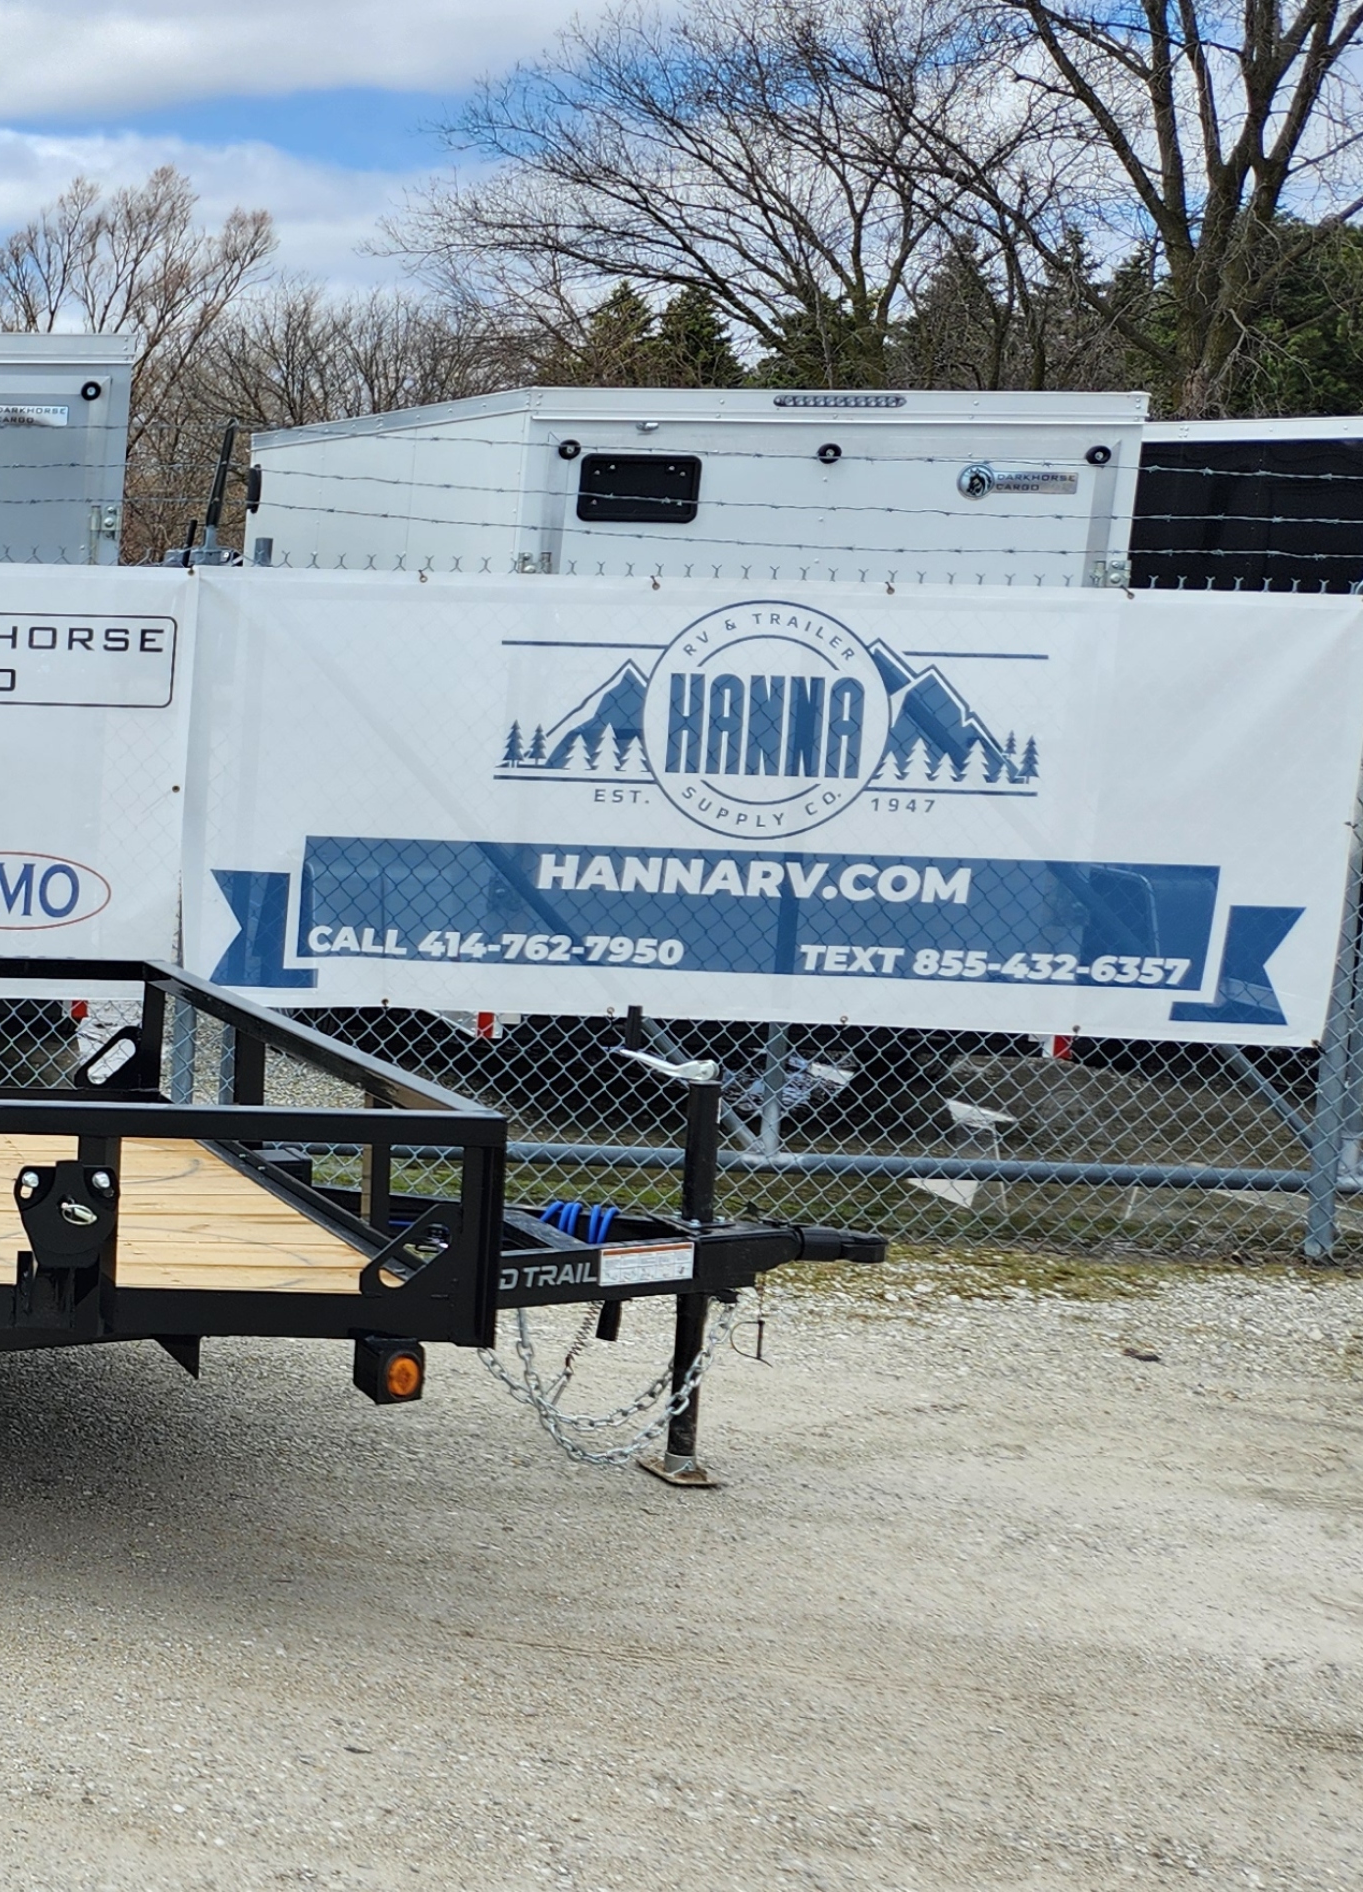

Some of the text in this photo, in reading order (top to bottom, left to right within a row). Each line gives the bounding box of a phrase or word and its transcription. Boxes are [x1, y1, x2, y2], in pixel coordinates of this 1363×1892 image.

[995, 483, 1040, 492] CARGO
[996, 473, 1076, 482] DARKHORSE
[682, 612, 856, 661] RV & TRAILER
[664, 672, 866, 779] HANNA
[593, 788, 650, 804] EST.
[681, 785, 842, 828] SUPPLY CO.
[870, 797, 936, 814] 1947
[536, 852, 973, 904] HANNARV.COM
[307, 924, 685, 966] CALL 414-762-7950
[799, 944, 1191, 987] TEXT 855-432-6357
[521, 1261, 598, 1289] TRAIL
